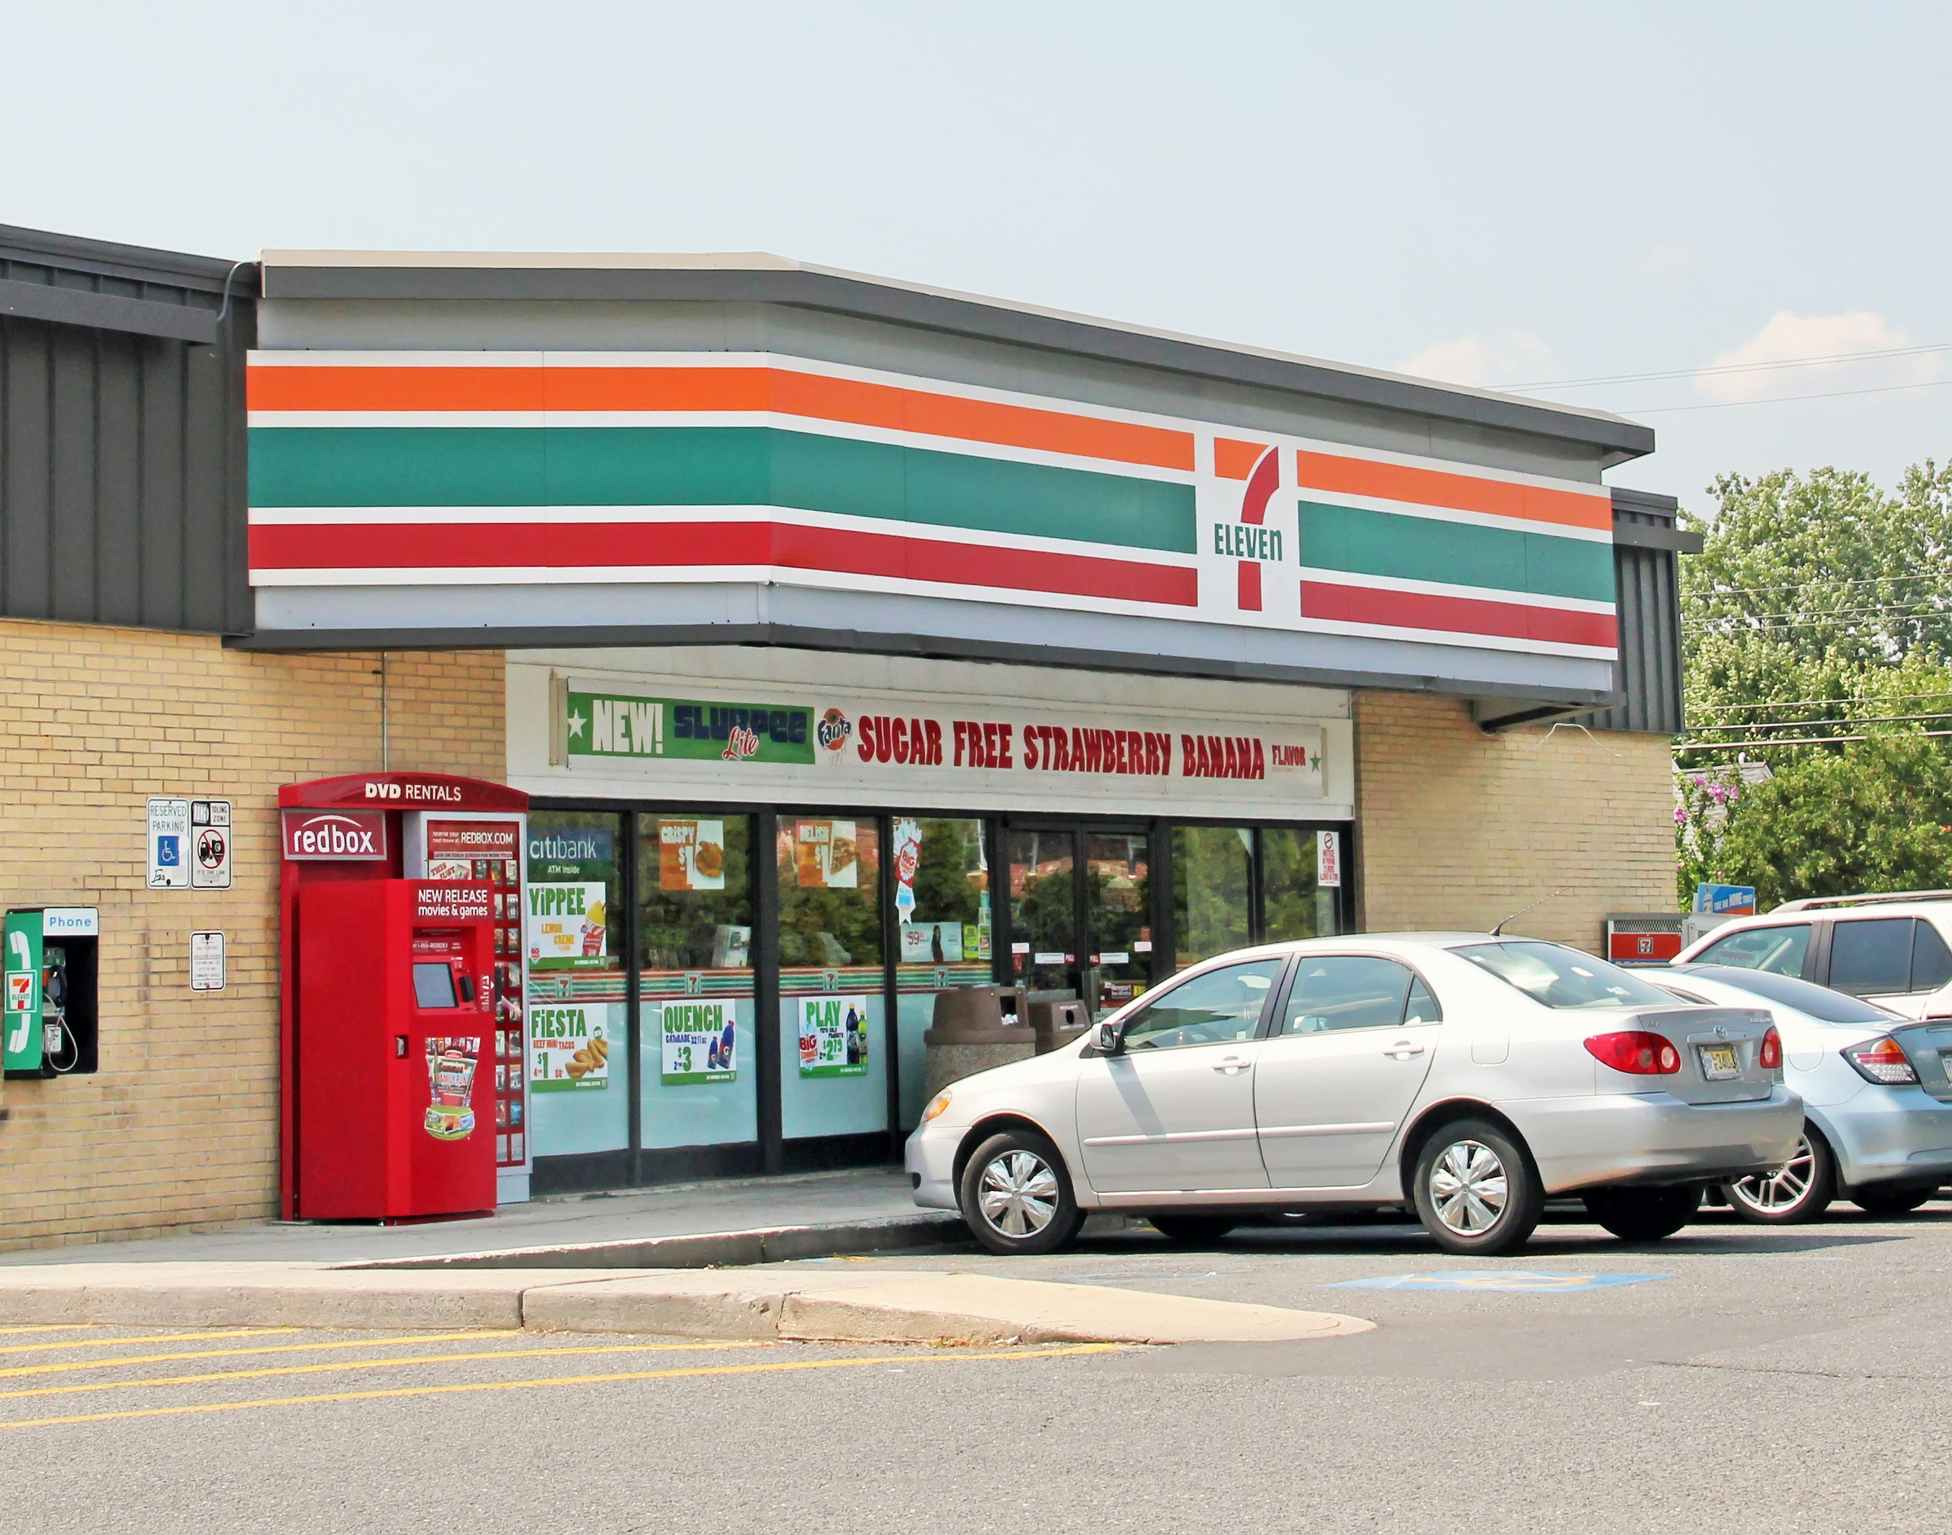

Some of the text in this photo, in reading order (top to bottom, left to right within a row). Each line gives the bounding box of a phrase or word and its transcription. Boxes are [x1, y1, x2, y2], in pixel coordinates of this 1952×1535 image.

[1213, 437, 1280, 612] 7
[592, 699, 664, 754] NEW!
[721, 726, 759, 760] Lite
[857, 715, 1306, 780] SUGAR FREE STRAWBERRY BANANA FLAVOR
[365, 782, 462, 801] DVD RENTALS
[293, 824, 372, 854] redbox
[460, 831, 513, 845] REDBOX.COM
[529, 834, 597, 860] citibank
[418, 889, 488, 903] NEW RELEASE
[49, 916, 92, 928] Phone
[418, 904, 489, 919] movies & games
[663, 1004, 724, 1034] QUENCH
[806, 1001, 842, 1028] PLAY
